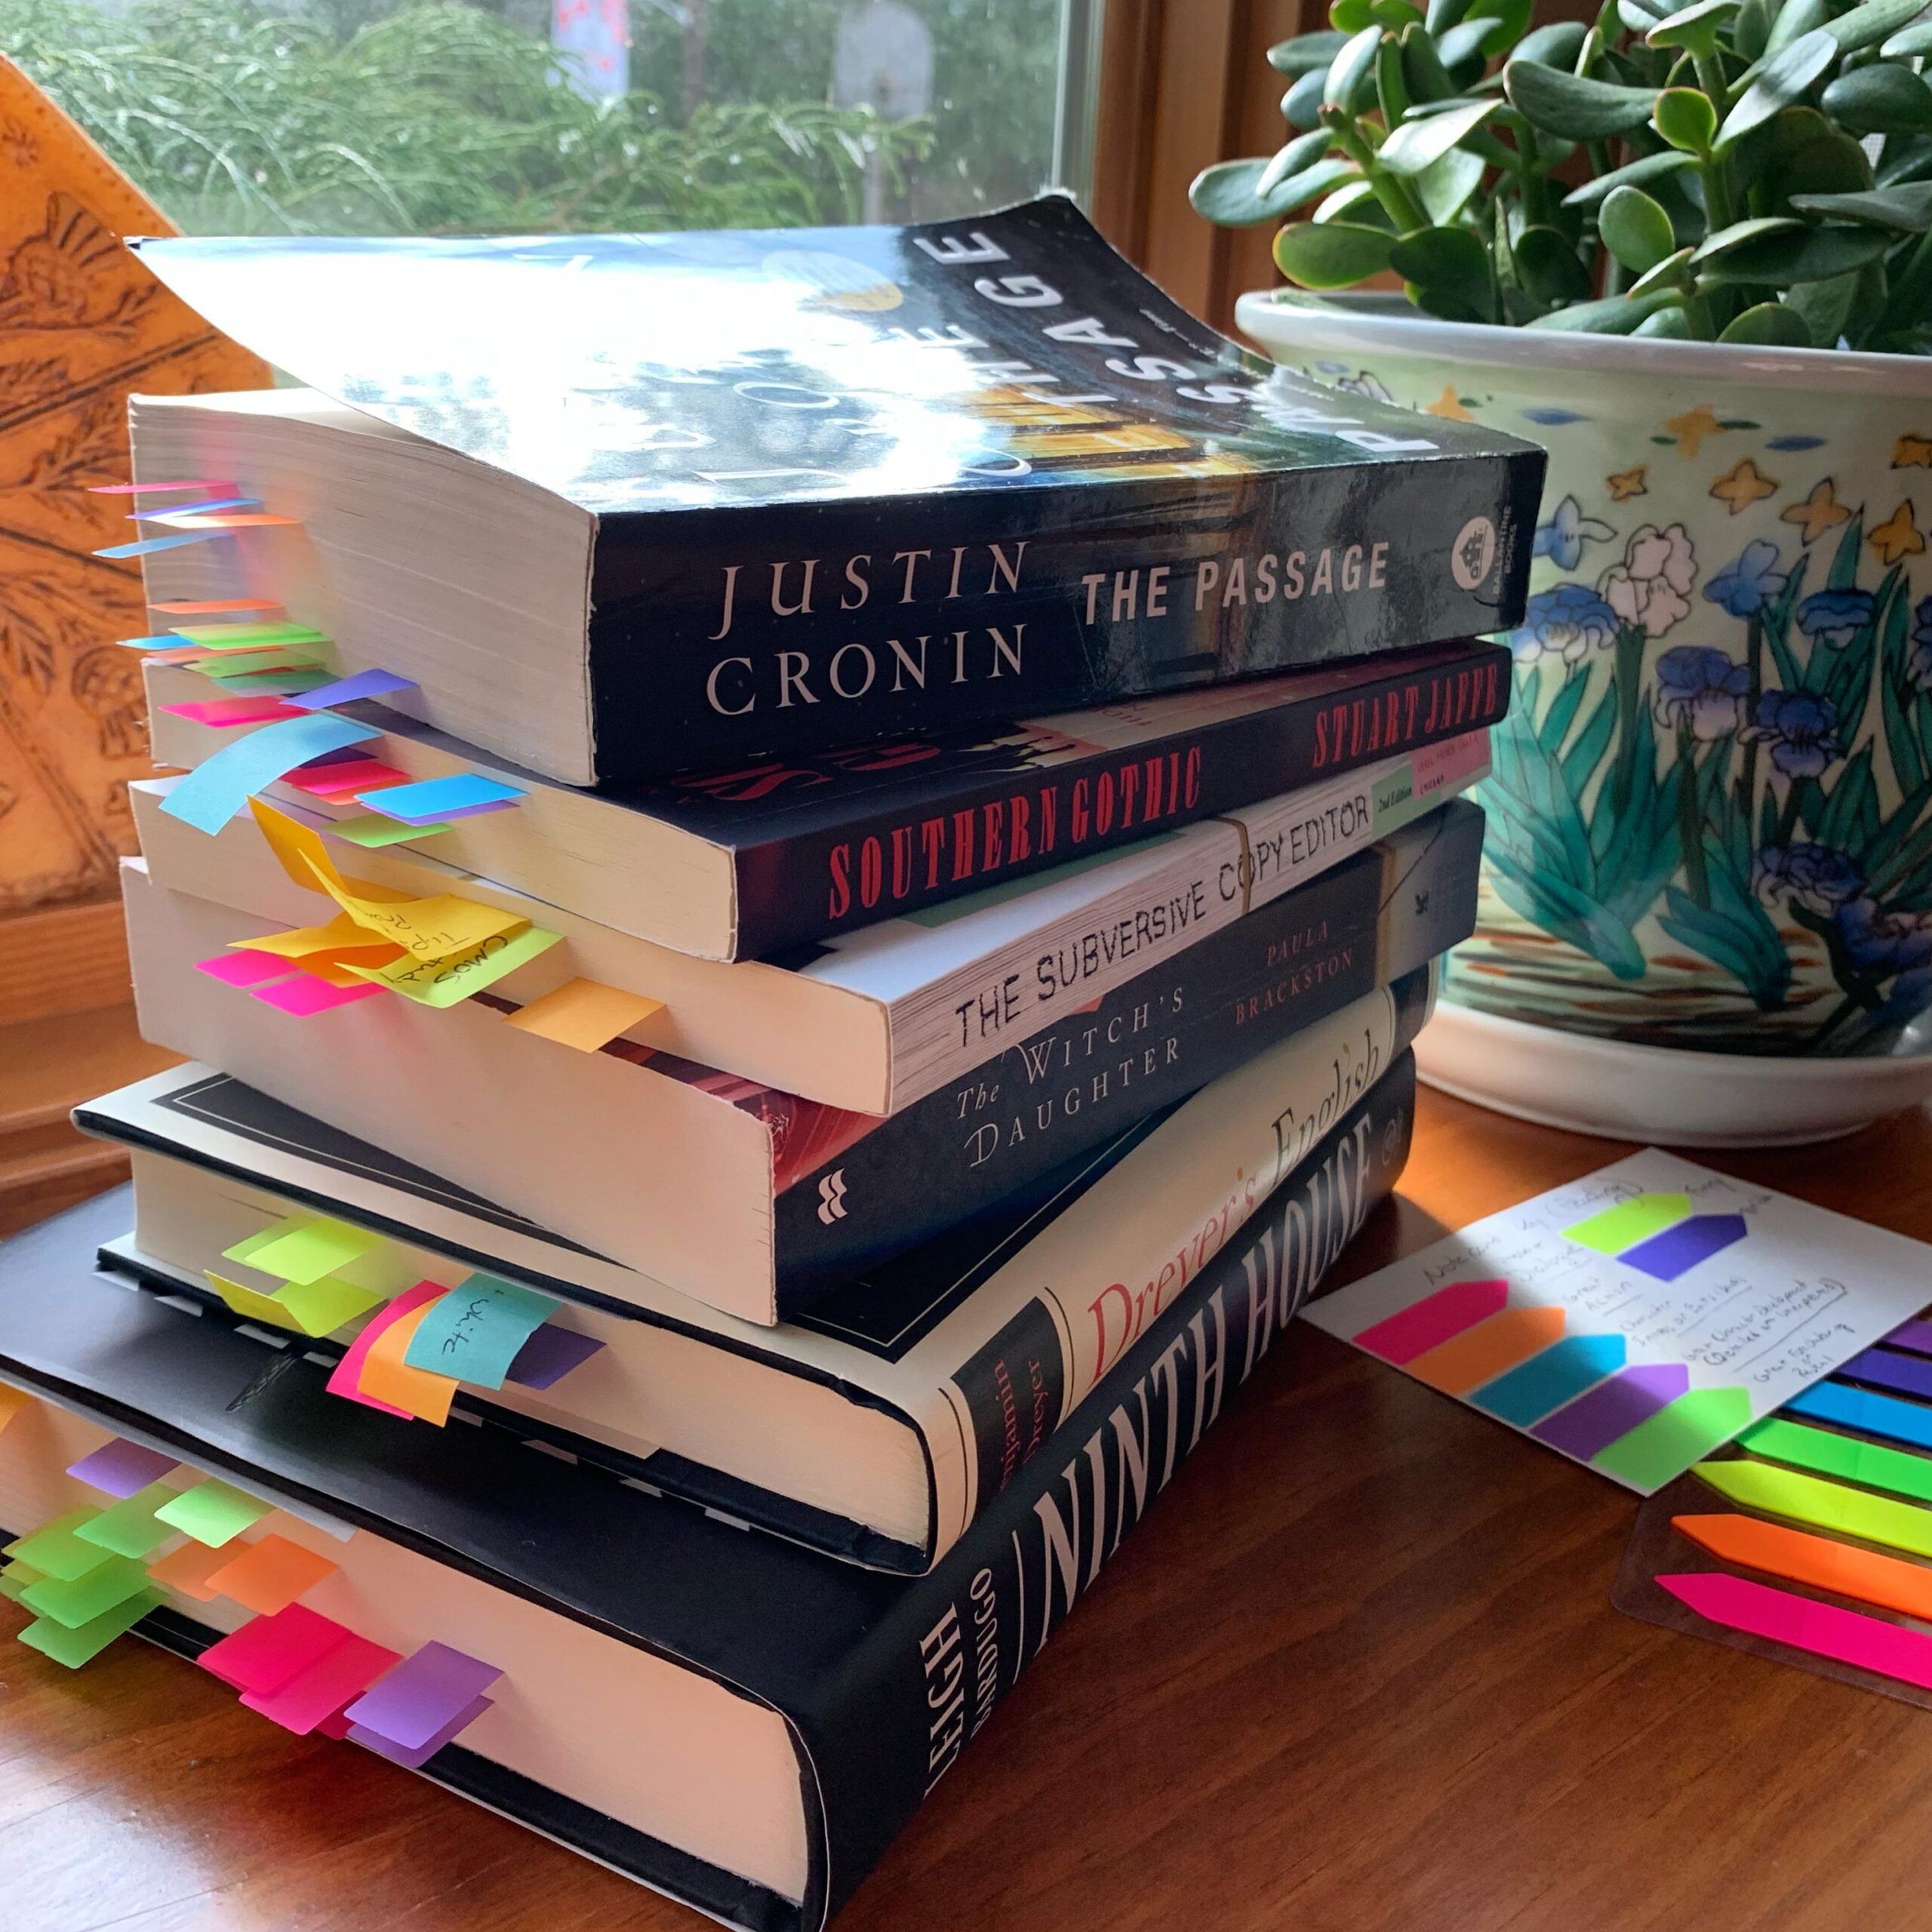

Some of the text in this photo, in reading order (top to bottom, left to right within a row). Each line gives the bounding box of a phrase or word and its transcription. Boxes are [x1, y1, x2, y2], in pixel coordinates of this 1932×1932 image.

[913, 232, 1440, 453] PASSAGE
[708, 540, 1031, 640] JUSTIN
[1081, 541, 1390, 626] THE PASSAGE
[706, 623, 1028, 715] CRONIN
[1312, 685, 1419, 768] STUART
[1424, 661, 1498, 734] JAFFE
[829, 785, 1057, 921] SOUTHERN
[1071, 746, 1202, 844] GOTHIC
[433, 935, 508, 984] CMOS
[955, 795, 1370, 1048] THE SUBVERSIVE COPY EDITOR
[1266, 920, 1329, 968] PAULA
[1235, 948, 1354, 1026] BRACKSTON
[957, 1081, 1001, 1121] The
[964, 1038, 1180, 1168] DAUGHTER
[1032, 1112, 1372, 1657] NINTH HOUSE
[920, 1601, 1001, 1801] LEIGH
[969, 1567, 999, 1740] BARDUGO
